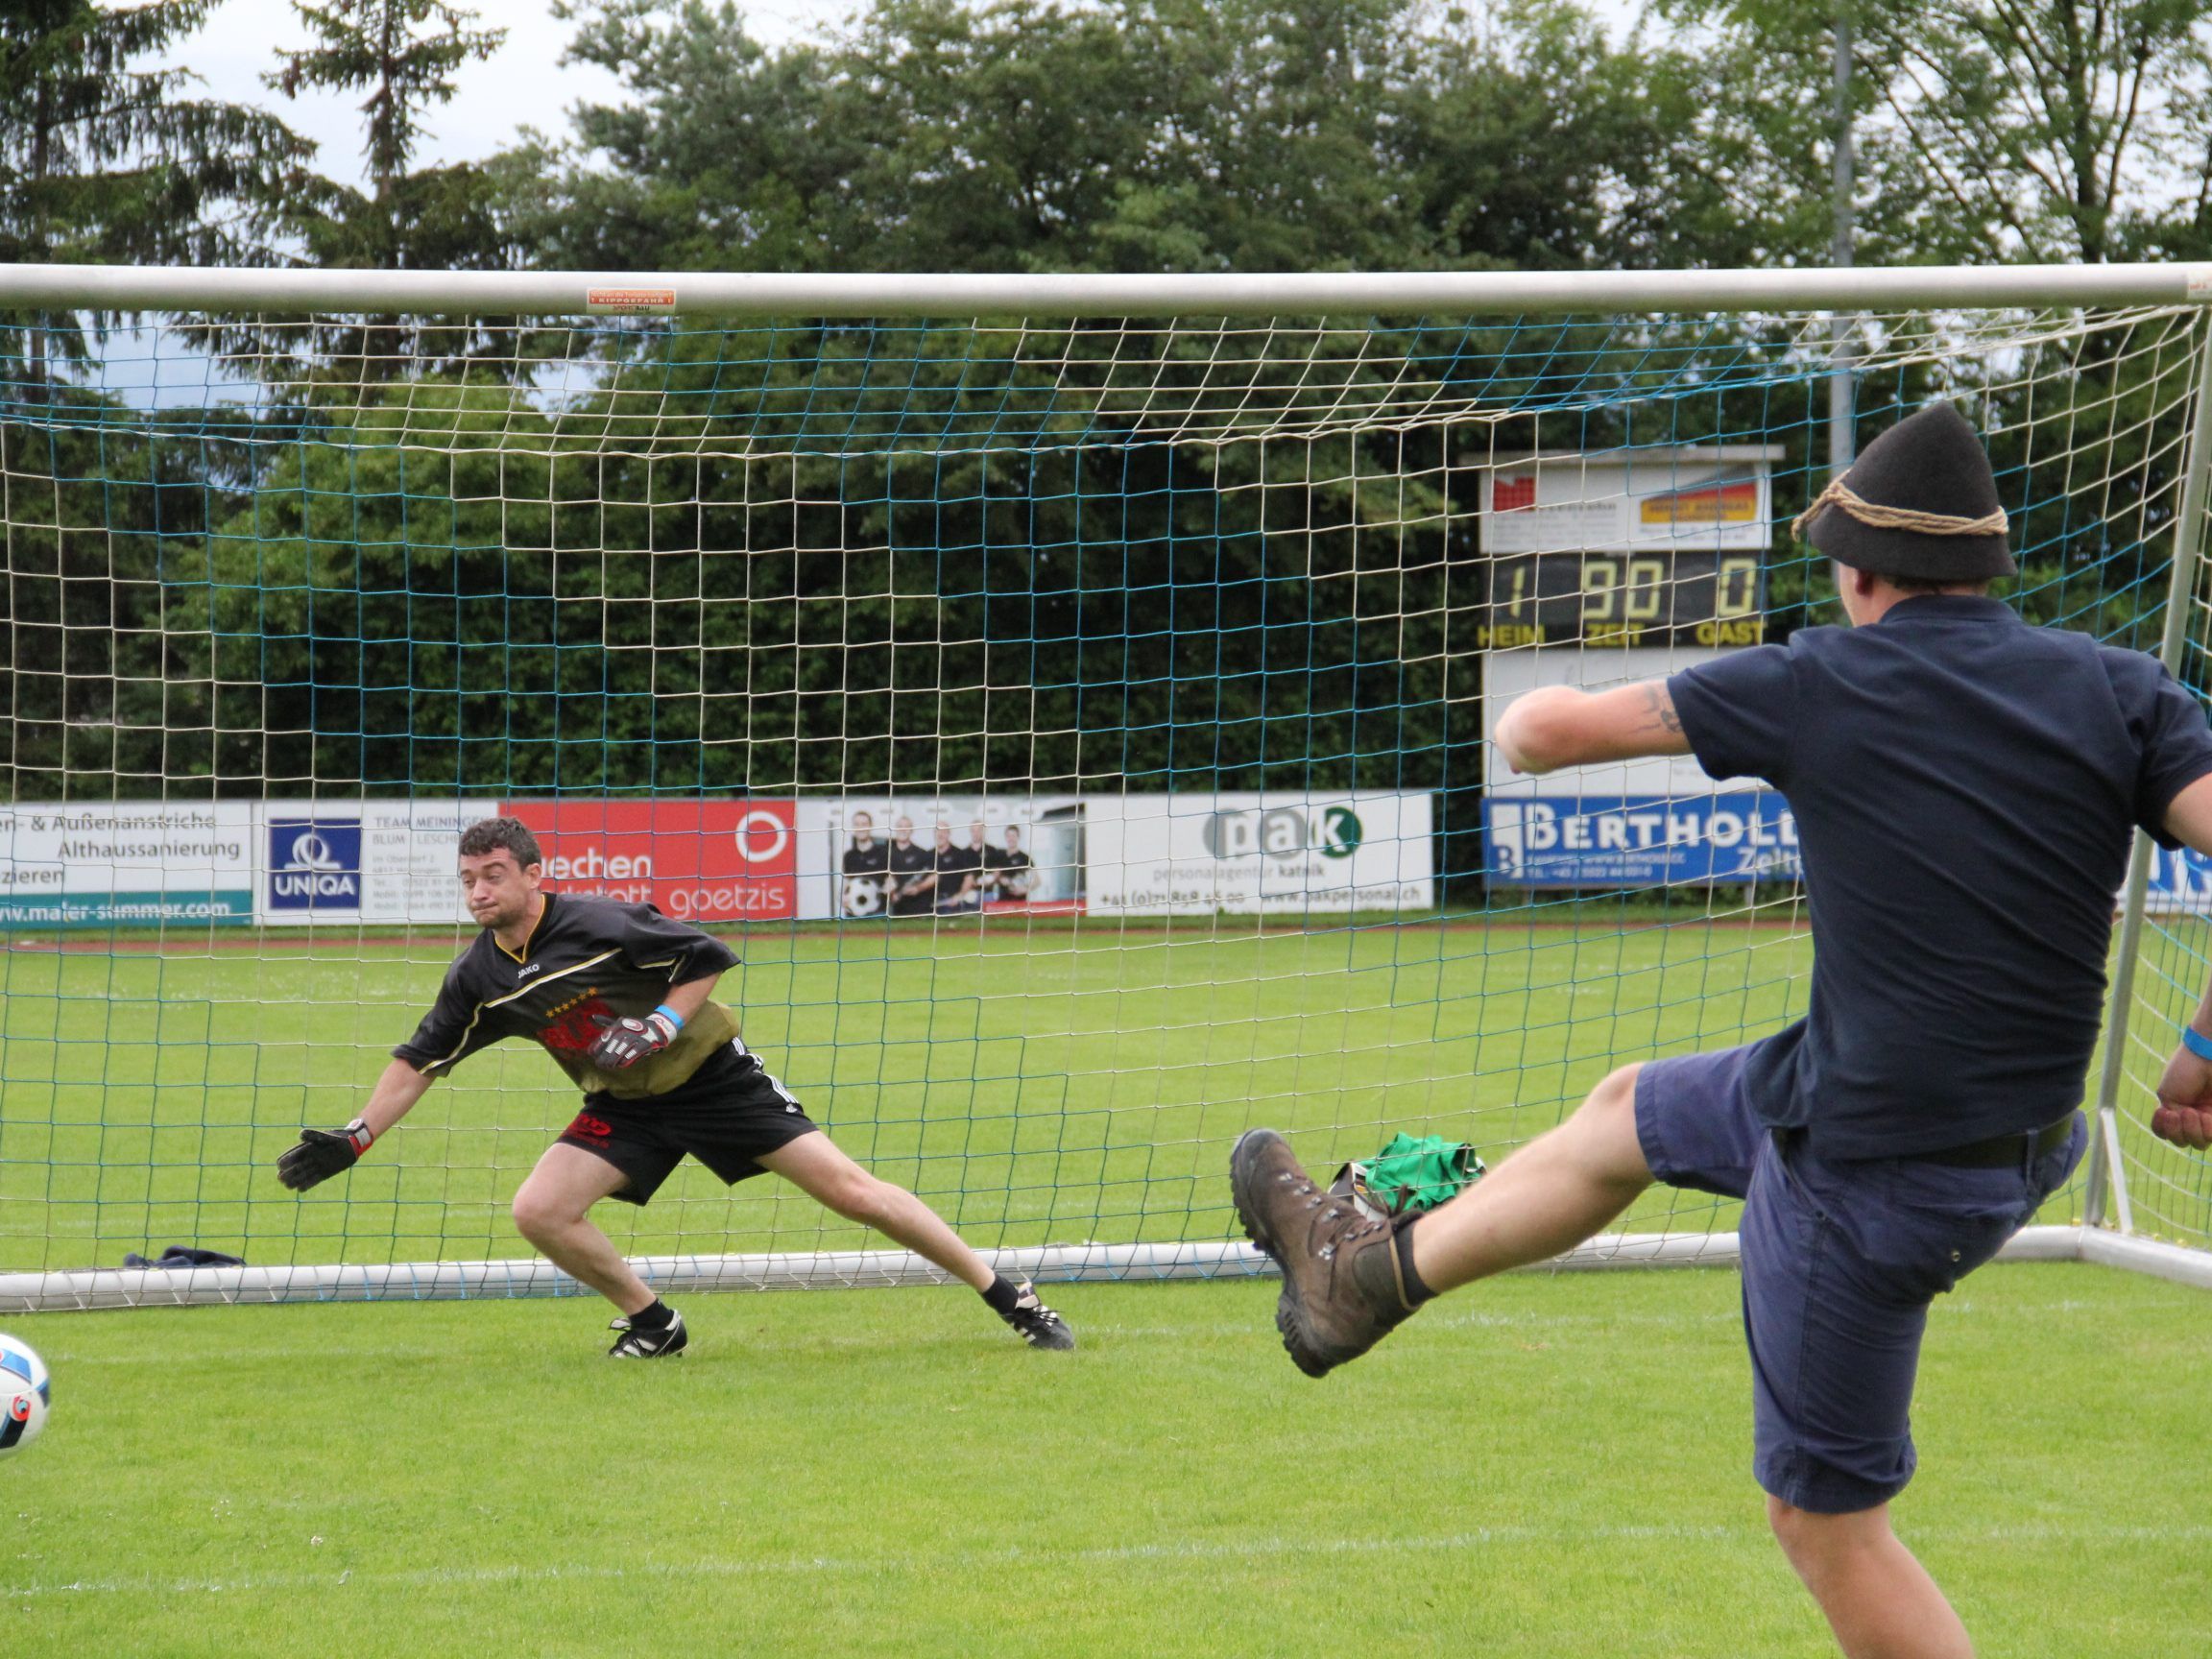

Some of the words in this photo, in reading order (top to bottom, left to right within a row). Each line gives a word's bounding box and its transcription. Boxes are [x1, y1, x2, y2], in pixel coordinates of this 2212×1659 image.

[1510, 566, 1525, 618] 1
[1582, 560, 1665, 619] 90
[1718, 558, 1757, 616] 0
[1477, 625, 1546, 647] HEIM
[1585, 623, 1645, 647] ZEIT
[1695, 621, 1768, 647] GAST
[52, 812, 216, 831] Außenanstriche
[375, 816, 410, 827] TEAM
[1203, 807, 1362, 860] pak
[58, 840, 240, 860] Althaussanierung
[275, 875, 354, 896] UNIQA
[669, 882, 785, 920] goetzis
[517, 963, 541, 979] JAKO
